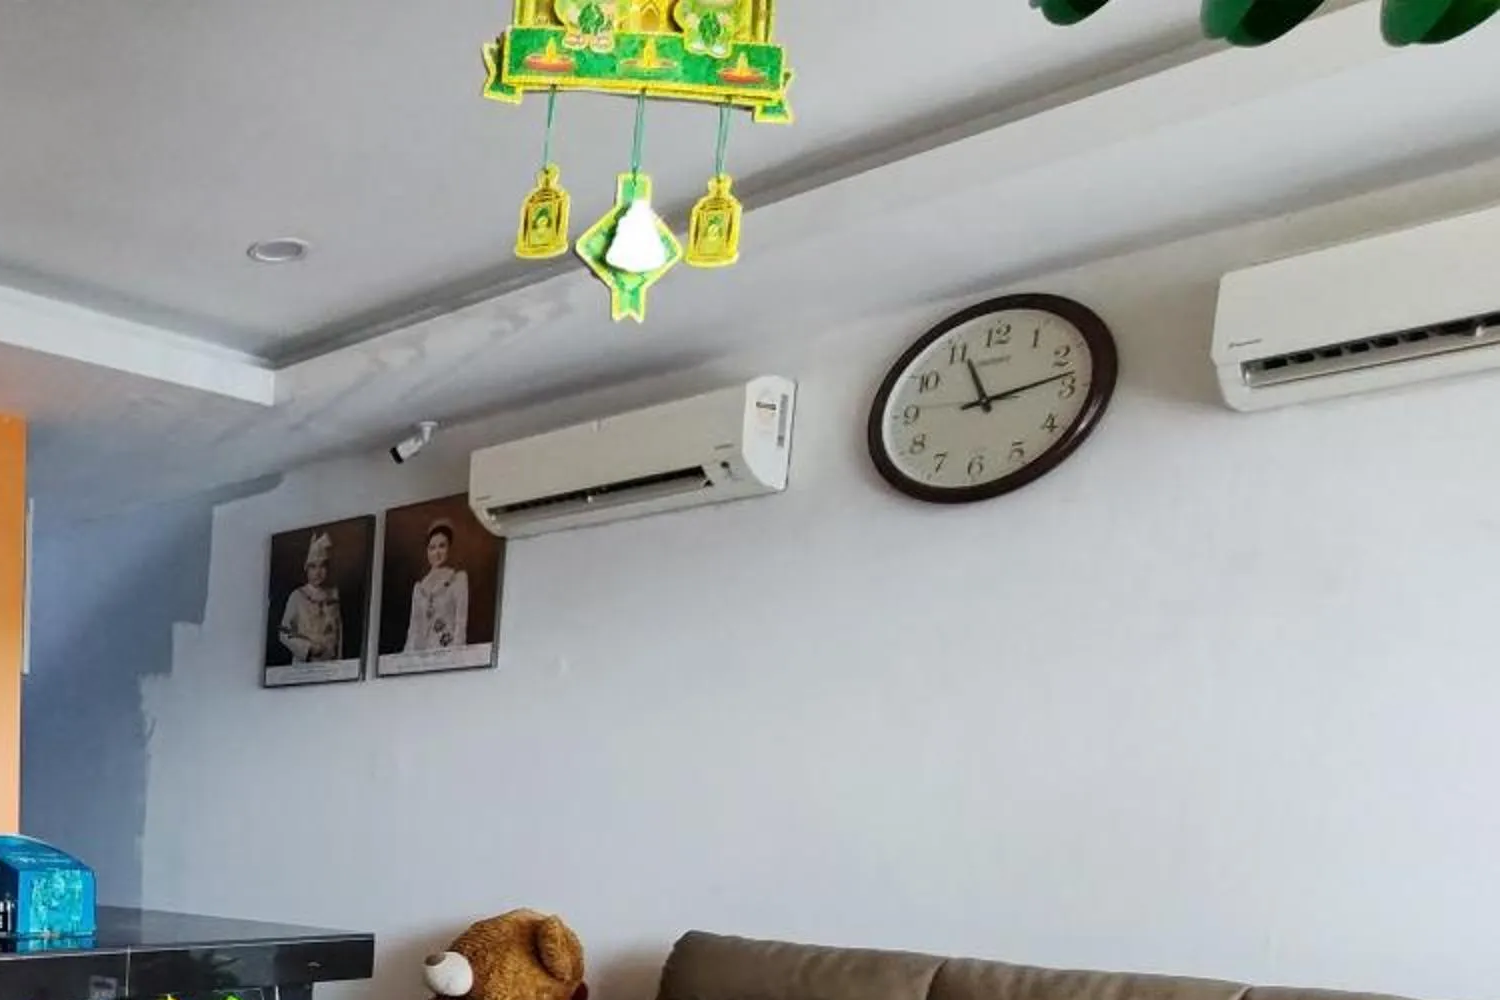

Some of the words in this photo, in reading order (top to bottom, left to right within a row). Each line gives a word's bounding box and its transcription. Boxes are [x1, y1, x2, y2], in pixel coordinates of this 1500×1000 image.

[985, 323, 1012, 349] 12
[1031, 328, 1040, 349] 1
[949, 343, 968, 365] 11
[1053, 345, 1071, 367] 2
[918, 370, 941, 393] 10
[1058, 376, 1077, 399] 3
[903, 404, 920, 425] 9
[1042, 413, 1058, 433] 4
[909, 433, 927, 454] 8
[1008, 440, 1025, 461] 5
[932, 452, 947, 473] 7
[966, 455, 984, 476] 6
